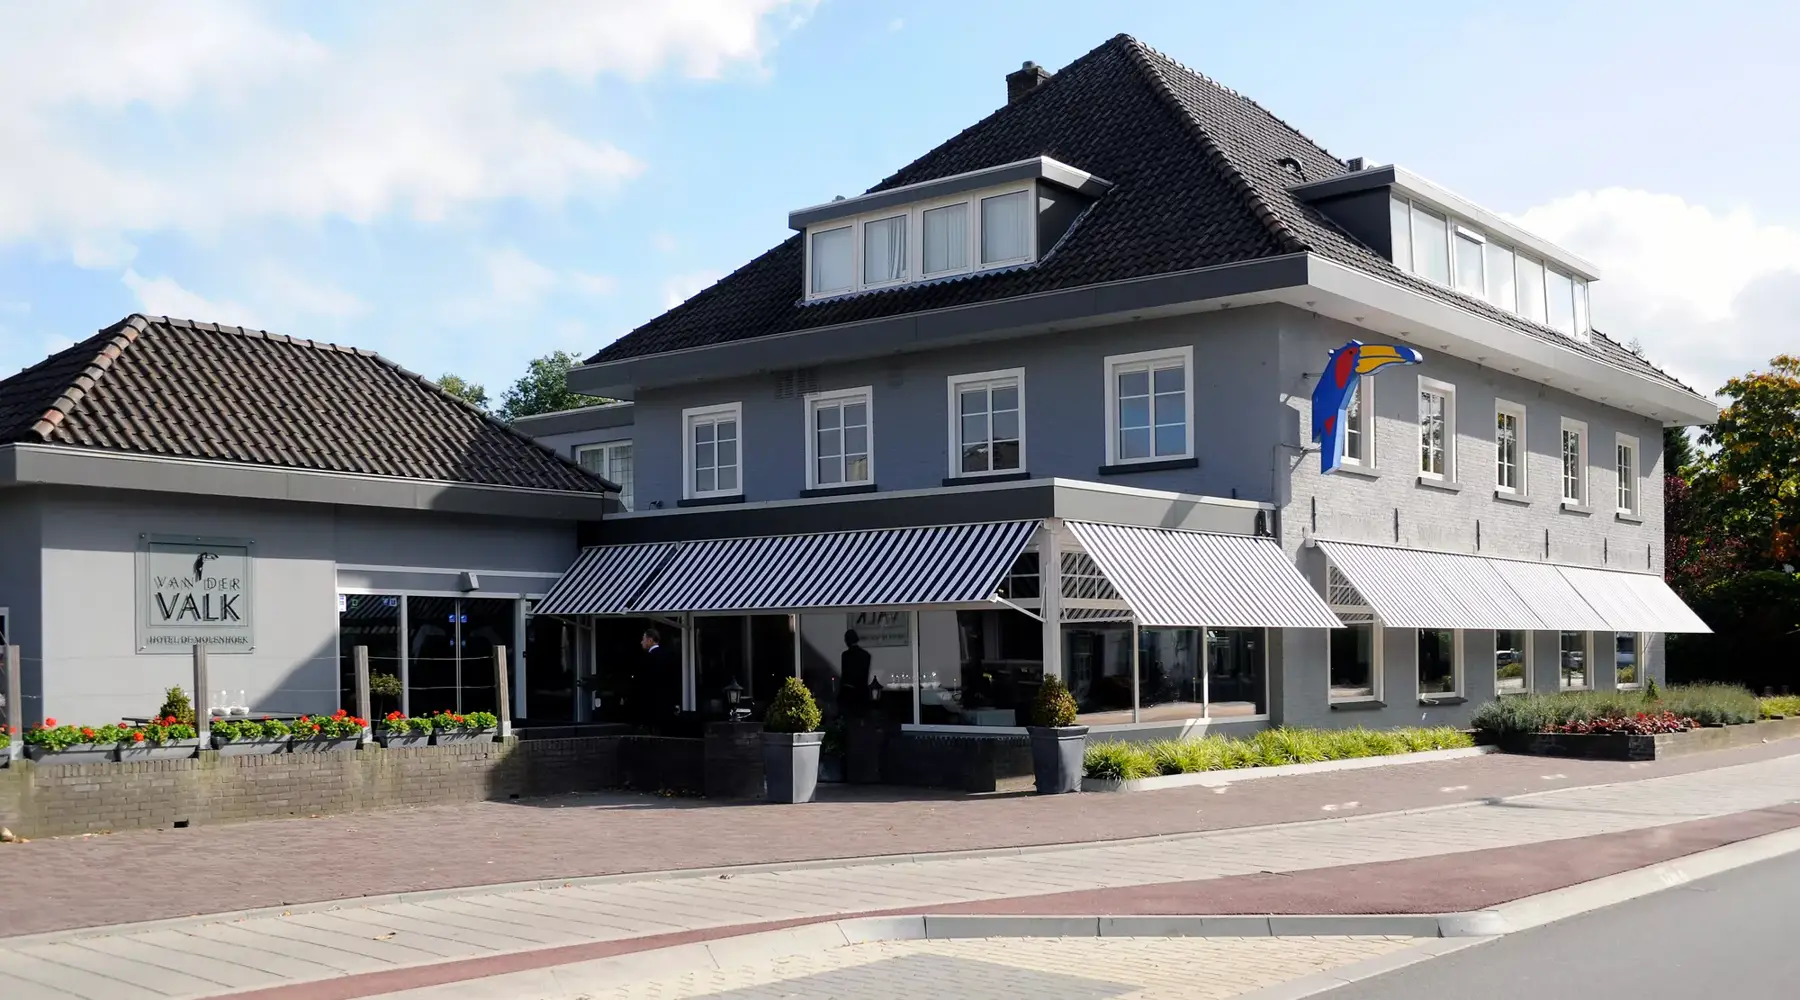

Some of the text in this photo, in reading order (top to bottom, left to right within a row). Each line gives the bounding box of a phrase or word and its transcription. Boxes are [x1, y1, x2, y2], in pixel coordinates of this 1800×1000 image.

[154, 576, 240, 590] VAN DER
[155, 592, 240, 621] VALK
[148, 635, 180, 645] HOTEL
[181, 636, 193, 645] DE
